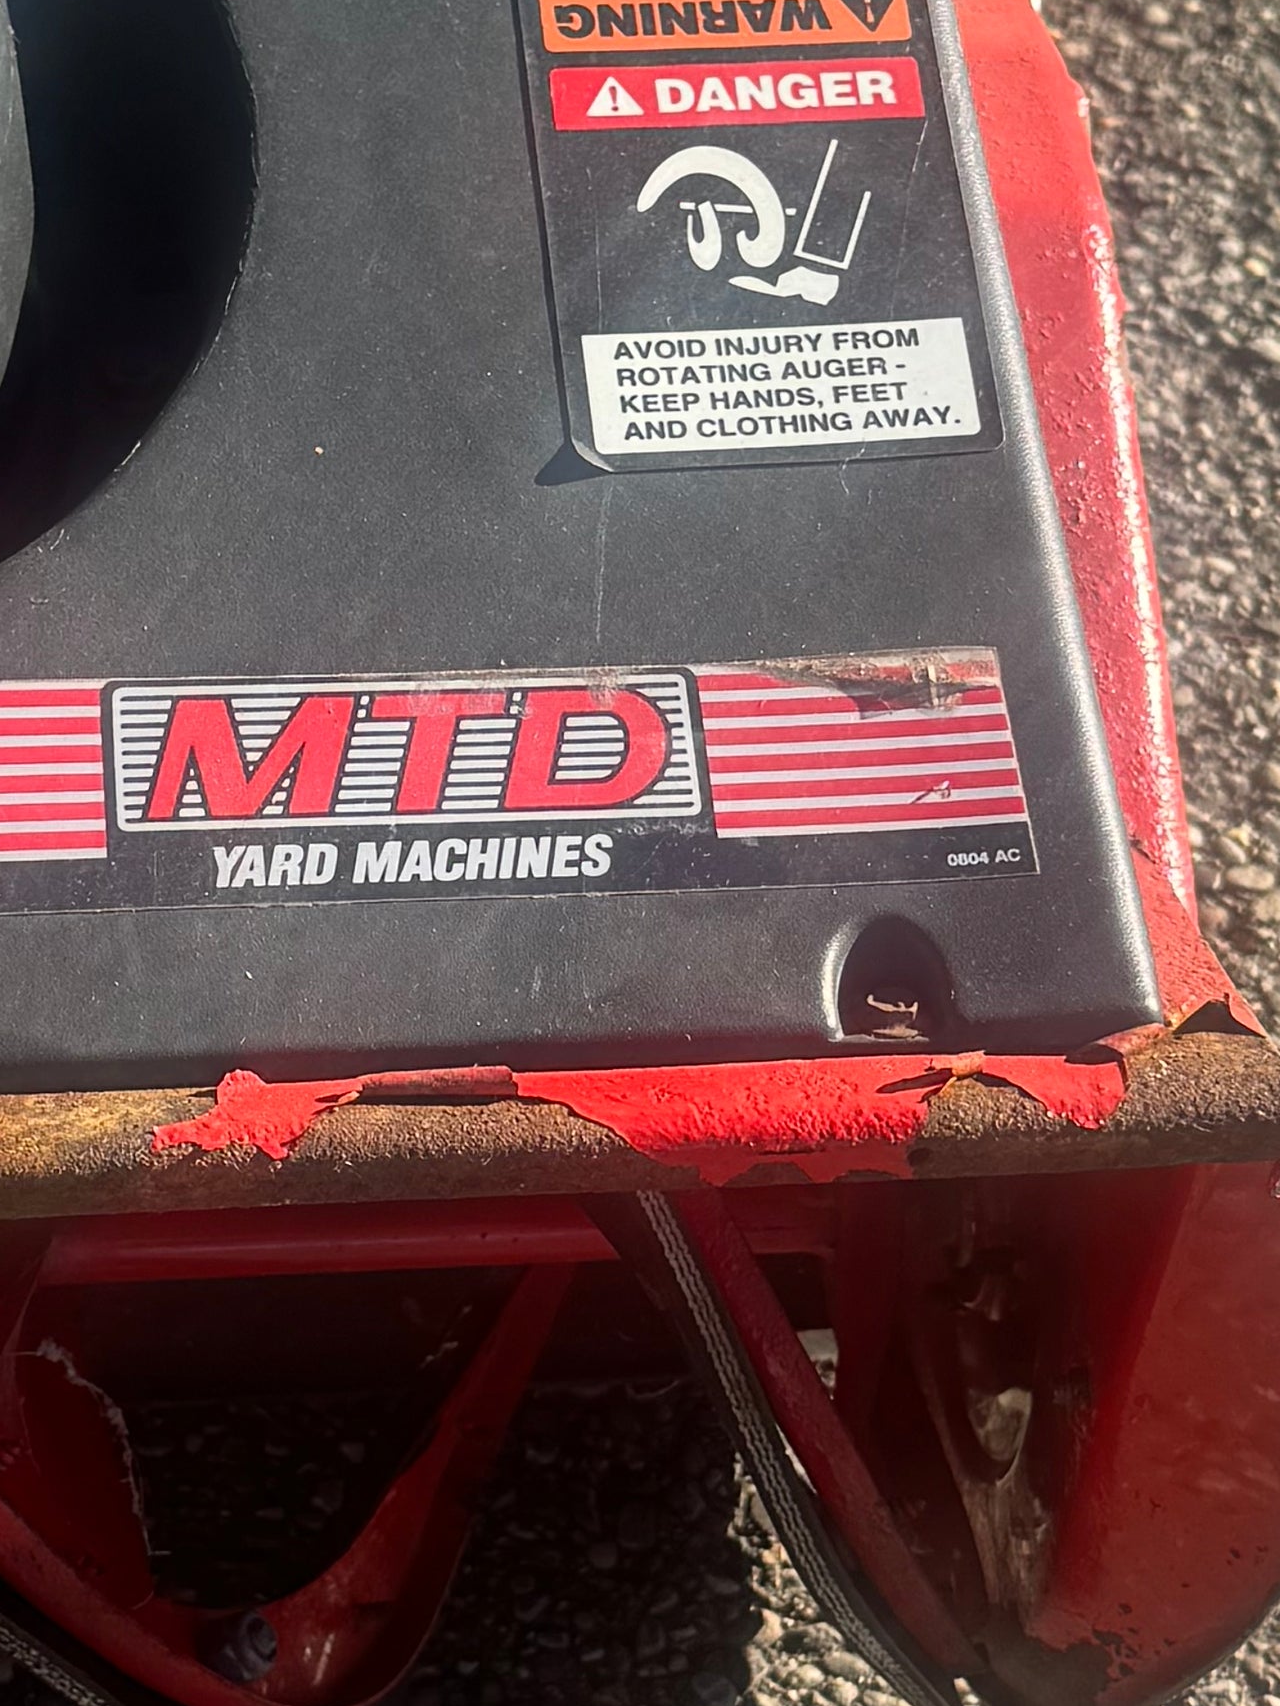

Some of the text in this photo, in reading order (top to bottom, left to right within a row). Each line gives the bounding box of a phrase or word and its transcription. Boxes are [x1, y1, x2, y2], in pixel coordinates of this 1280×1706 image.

[654, 71, 896, 113] DANGER
[614, 328, 919, 360] AVOID INJURY FROM
[617, 362, 772, 387] ROTATING
[781, 357, 887, 379] AUGER
[620, 382, 907, 414] KEEP HANDS, FEET
[624, 405, 960, 441] AND CLOTHING AWAY.
[145, 689, 672, 821] MTD
[214, 834, 614, 888] YARD MACHINES
[995, 848, 1021, 863] AC
